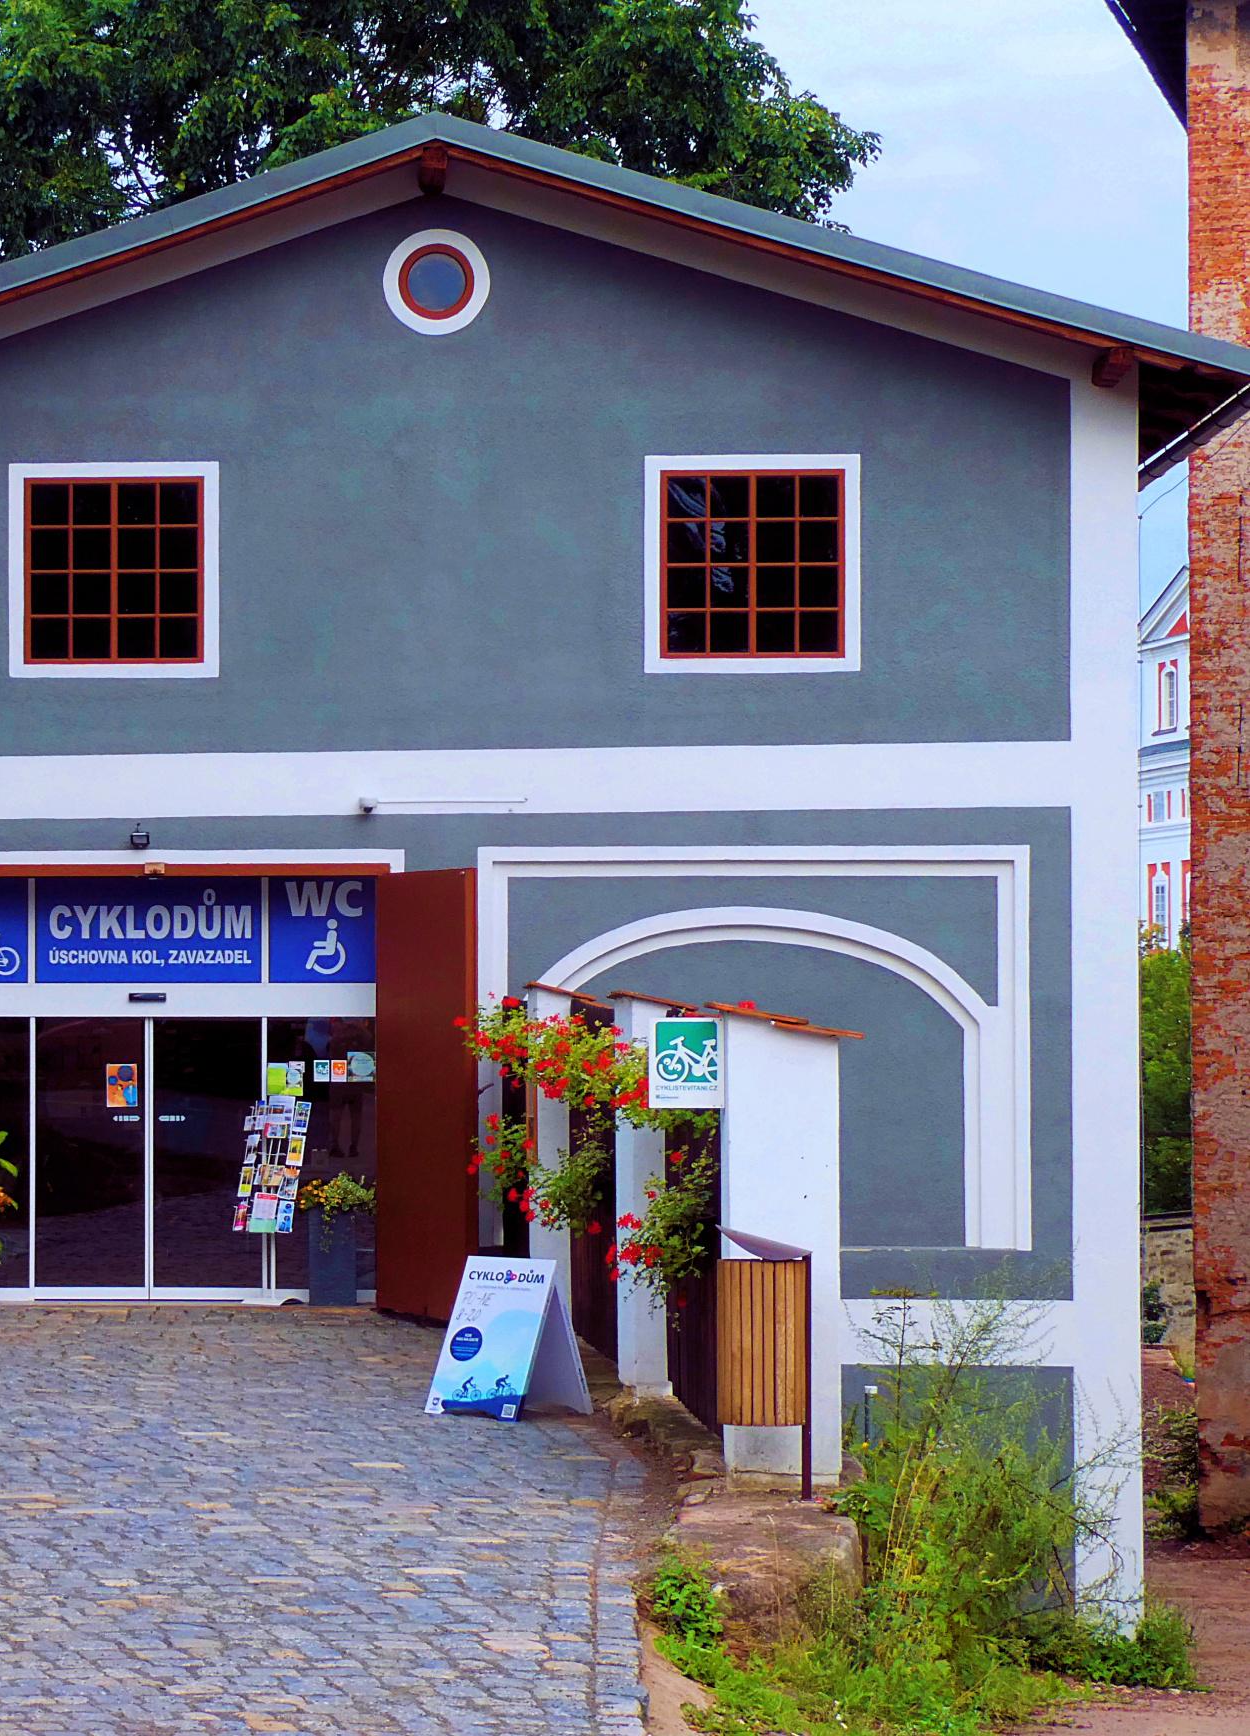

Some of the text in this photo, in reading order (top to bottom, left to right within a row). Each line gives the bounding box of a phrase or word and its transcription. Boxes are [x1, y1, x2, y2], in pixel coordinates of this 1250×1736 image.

[285, 881, 363, 918] WC
[49, 889, 252, 940] CYKLODŮM
[49, 948, 252, 966] ÚSCHOVNA KOL, ZAVAZADEL
[469, 1269, 545, 1283] CYKLO DŮM
